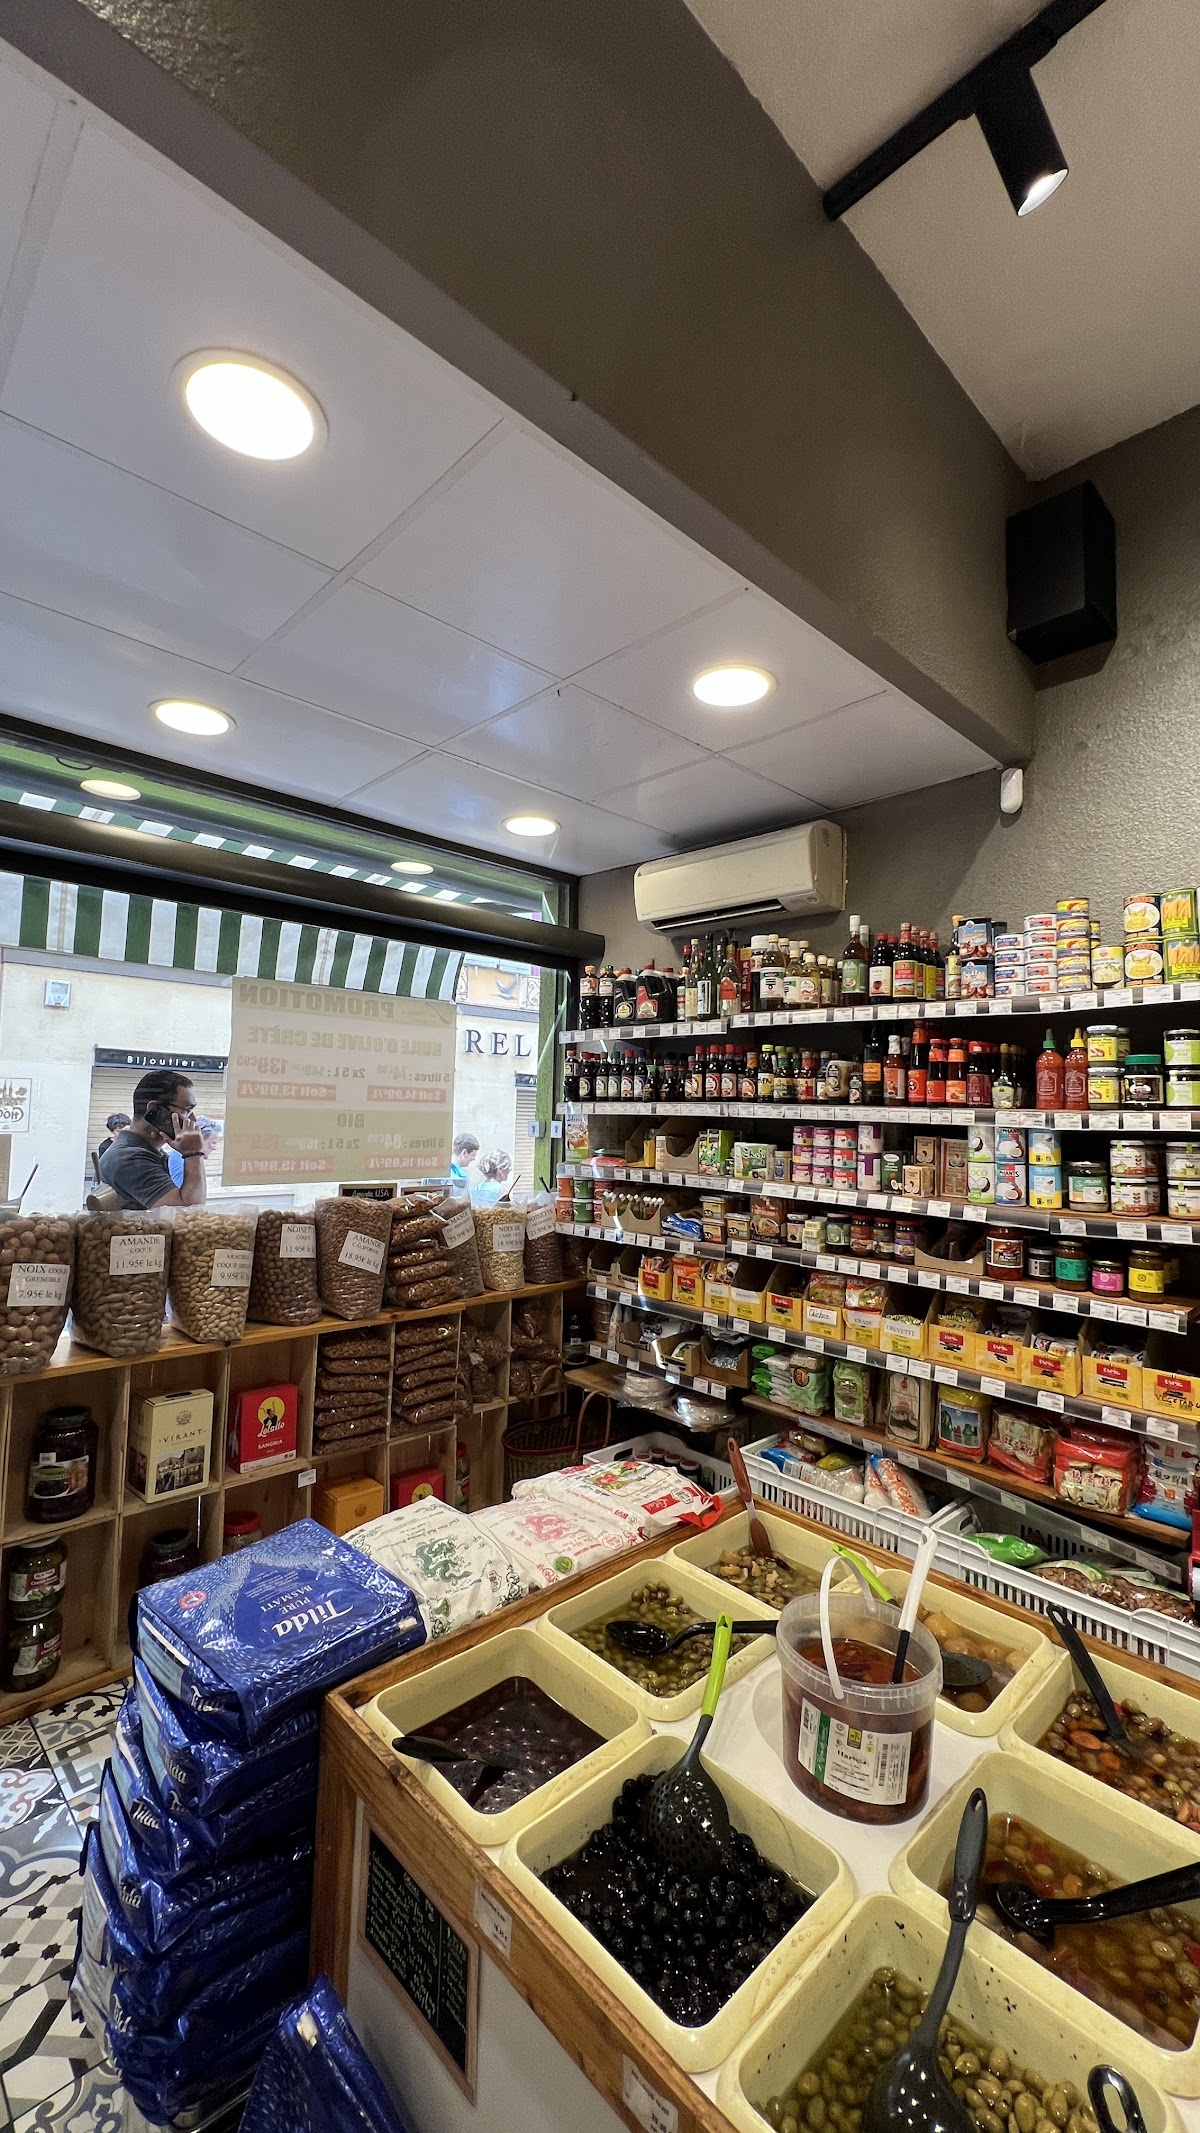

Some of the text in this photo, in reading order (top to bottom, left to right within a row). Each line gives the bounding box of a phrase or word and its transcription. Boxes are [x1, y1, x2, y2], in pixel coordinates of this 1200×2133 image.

[127, 1055, 195, 1067] Bijoutier
[374, 1187, 389, 1198] USA
[119, 1236, 161, 1247] AMANDE
[352, 1233, 382, 1249] AMANDE
[115, 1258, 163, 1269] 11.95€ le kg
[17, 1264, 46, 1275] NOIX
[25, 1276, 61, 1284] GRENOBLE
[219, 1271, 239, 1280] 9.95€
[18, 1289, 64, 1302] 7.95€ le kg
[163, 1428, 203, 1443] VIRANT
[257, 1439, 283, 1450] SANGRIA
[260, 1584, 313, 1613] BASMATI
[279, 1597, 311, 1614] PURE
[271, 1599, 354, 1638] Tilda
